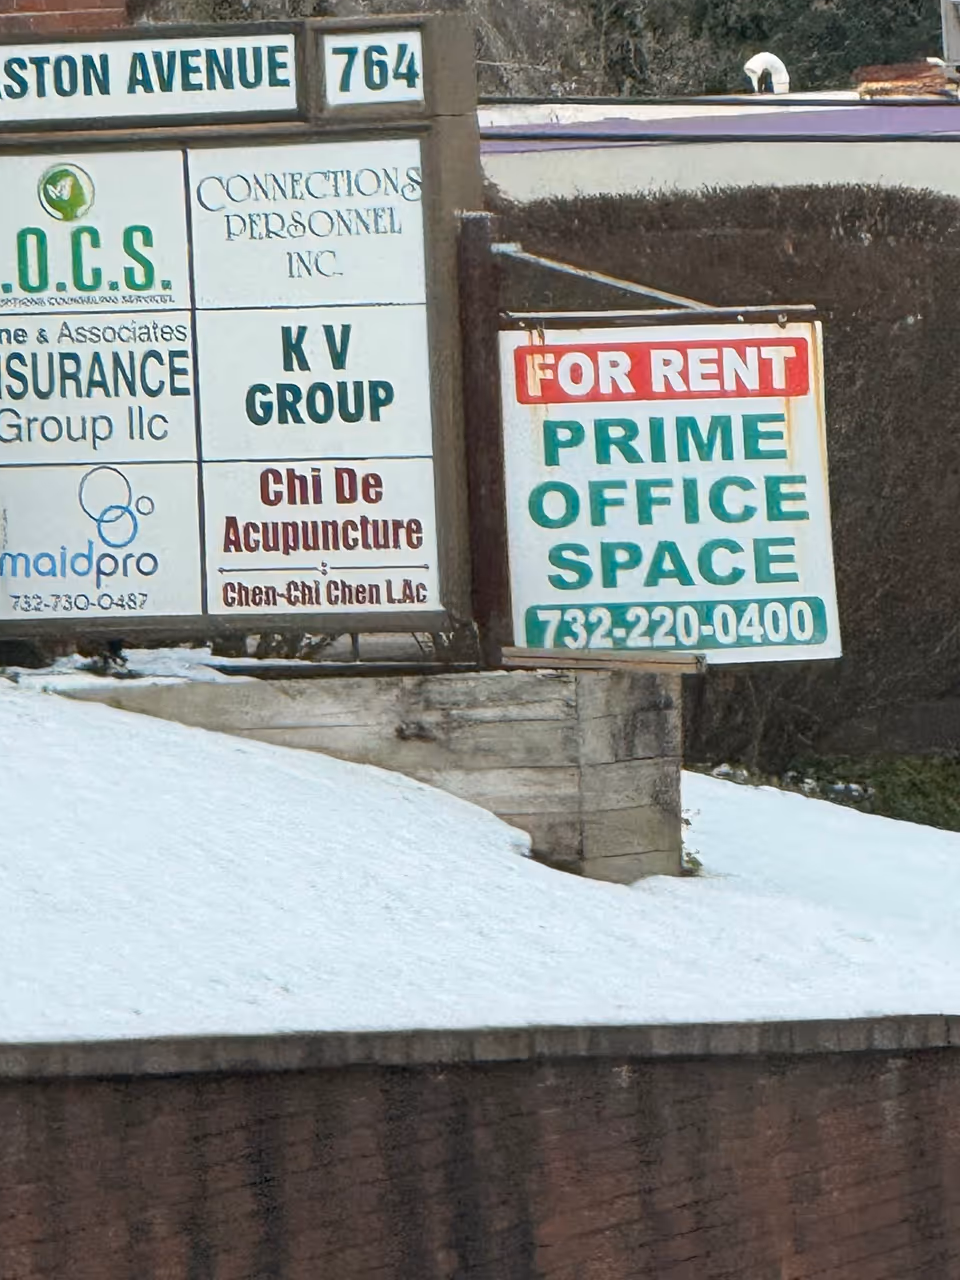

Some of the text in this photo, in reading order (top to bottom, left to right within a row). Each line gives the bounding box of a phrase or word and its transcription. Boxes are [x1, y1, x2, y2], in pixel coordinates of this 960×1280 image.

[127, 45, 291, 94] AVENUE
[331, 43, 420, 92] 764
[196, 167, 423, 212] CONNECTIONS
[224, 207, 402, 241] PERSONNEL
[36, 328, 50, 344] &
[57, 320, 188, 344] Associates
[280, 323, 352, 372] K V
[525, 345, 797, 397] FOR RENT
[127, 406, 169, 440] llc
[245, 380, 395, 426] GROUP
[542, 413, 788, 467] PRIME
[259, 467, 383, 506] Chi De
[528, 475, 810, 529] OFFICE
[223, 515, 424, 556] Acupuncture
[0, 539, 159, 589] maidpro
[547, 537, 799, 590] SPACE
[222, 579, 321, 607] Chen-Chi
[326, 579, 381, 606] Chen
[536, 600, 814, 649] 732-220-0400
